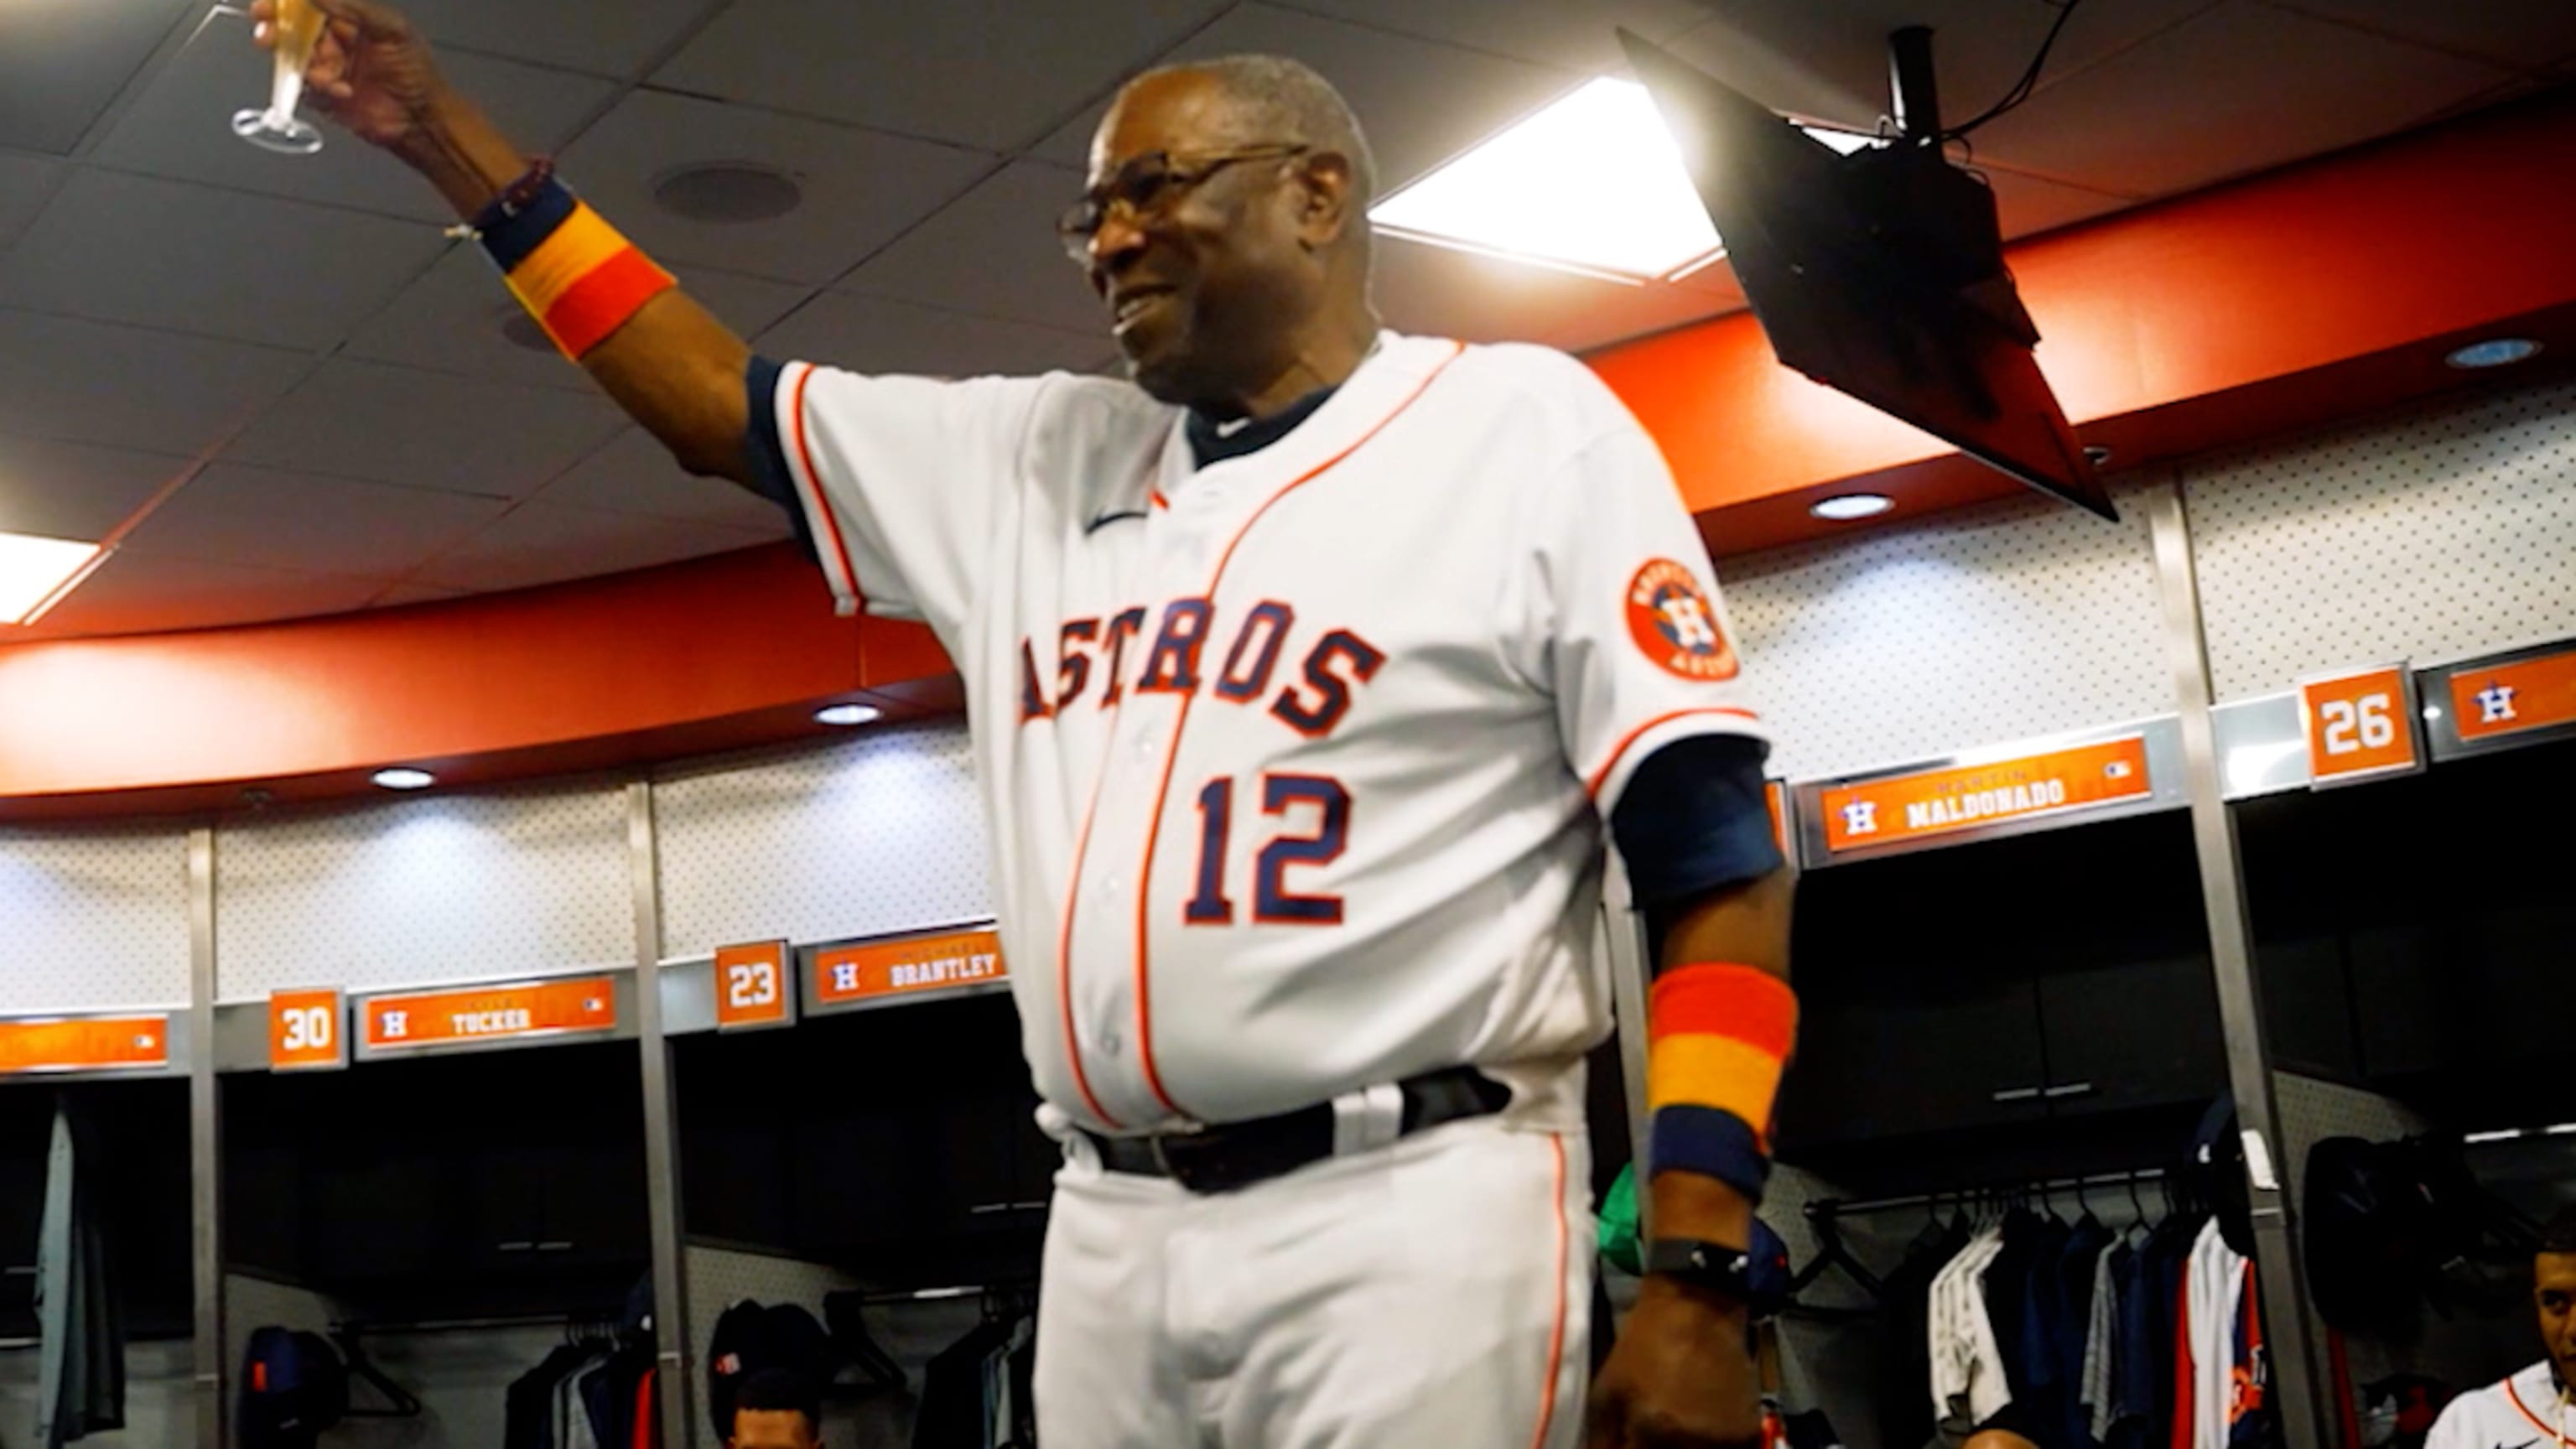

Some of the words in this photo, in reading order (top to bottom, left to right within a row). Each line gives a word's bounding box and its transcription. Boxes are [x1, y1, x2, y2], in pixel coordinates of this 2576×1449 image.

[1019, 595, 1388, 738] ASTROS
[2319, 693, 2394, 756] 26
[1905, 778, 2066, 829] MALDONADO
[1182, 771, 1353, 926] 12
[728, 962, 776, 1008] 23
[891, 953, 997, 988] BRANTLEY
[281, 1006, 331, 1051] 30
[451, 1008, 531, 1036] TUCKER
